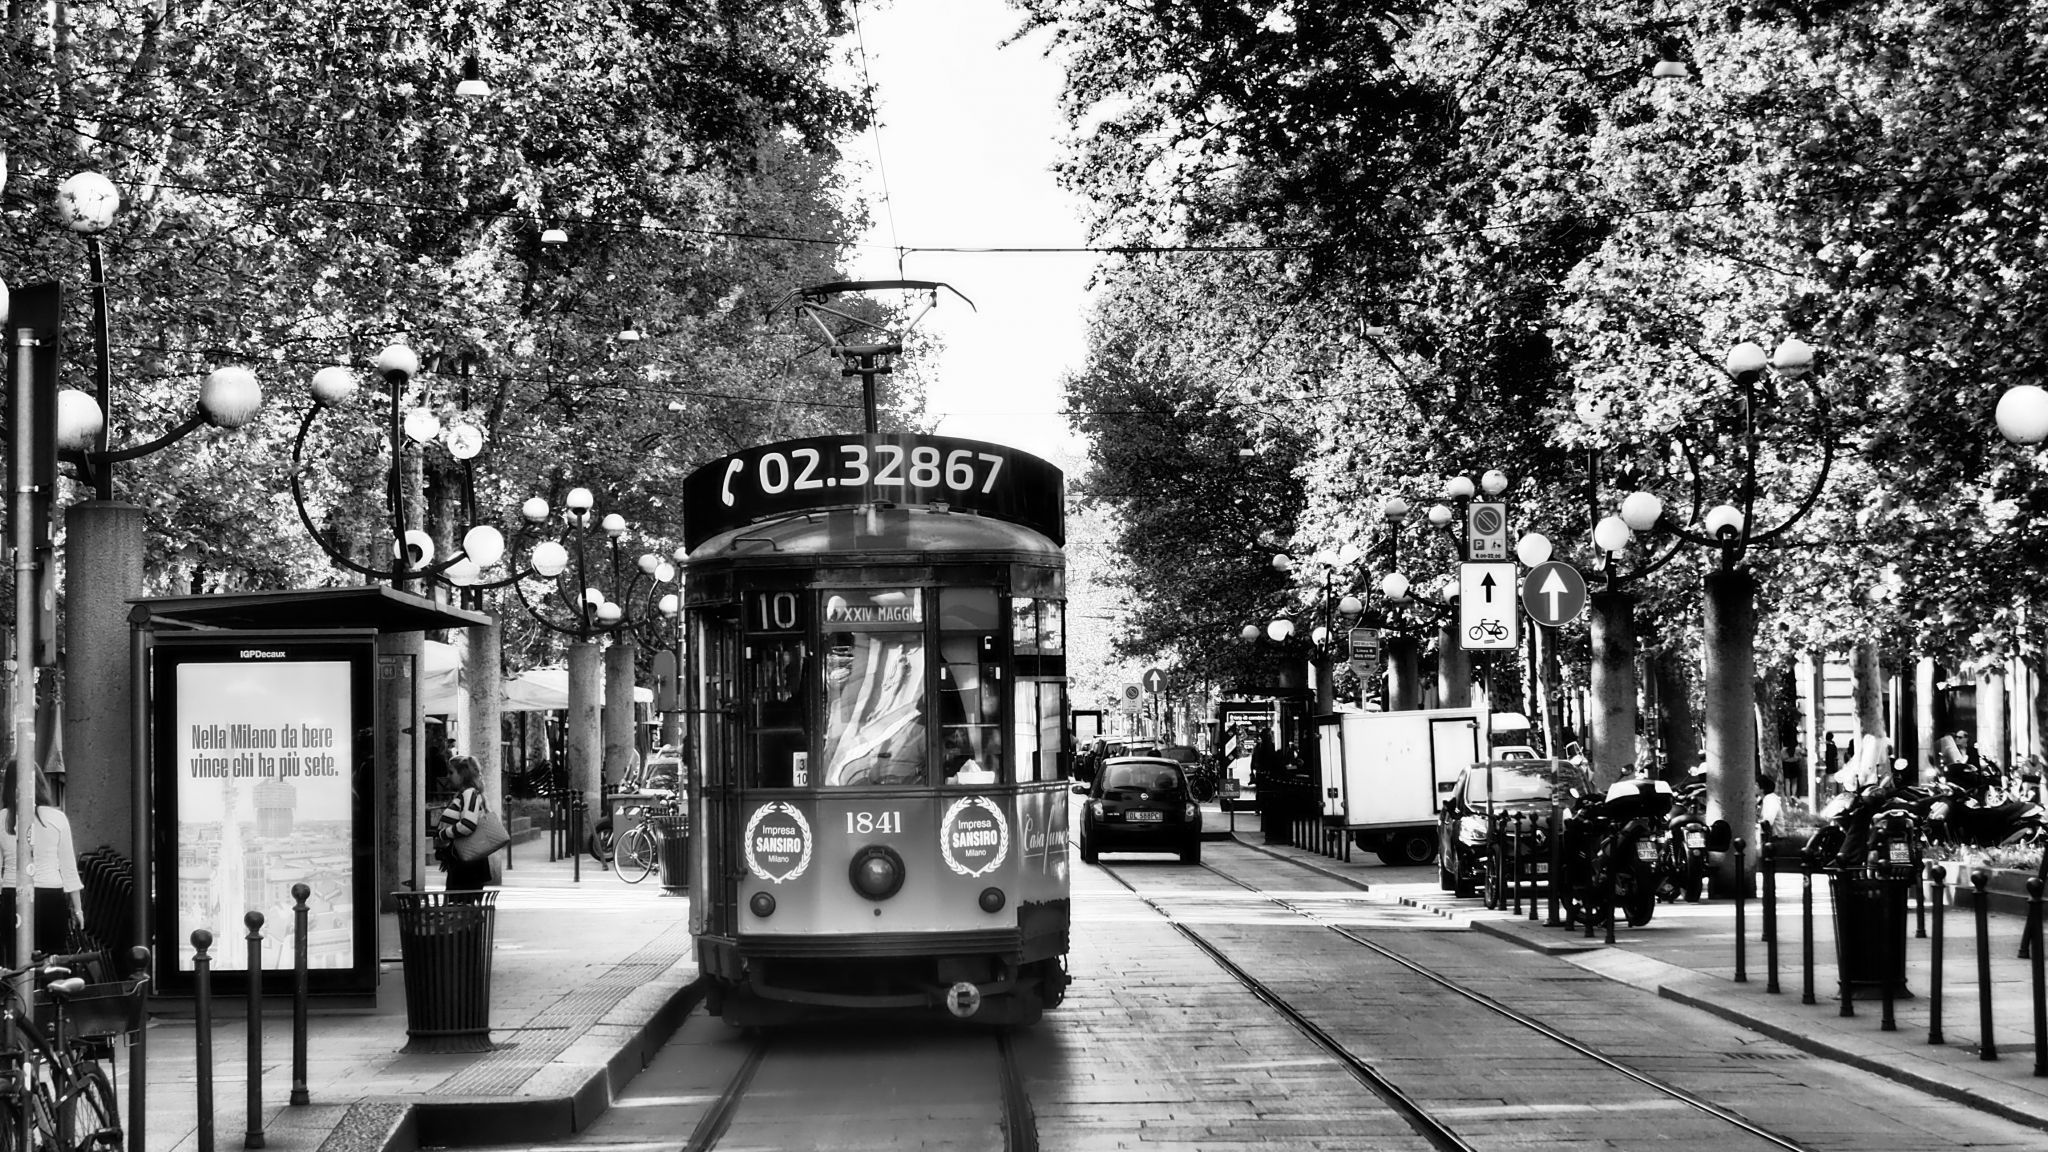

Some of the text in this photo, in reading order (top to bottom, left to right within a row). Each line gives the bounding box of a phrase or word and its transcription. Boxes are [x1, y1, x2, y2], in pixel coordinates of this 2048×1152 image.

[759, 445, 1004, 494] 02.32867
[760, 592, 796, 630] 10
[844, 607, 873, 622] XXIV
[878, 606, 921, 622] MAGGI
[240, 650, 286, 659] IGPDecaux
[191, 723, 333, 750] Nella Milano da bere
[190, 751, 339, 782] vince chi ha più sete.
[799, 759, 805, 771] 3
[796, 773, 808, 785] 10
[846, 811, 901, 834] 1841
[958, 819, 992, 831] Impresa
[762, 825, 796, 837] Impresa
[952, 829, 998, 848] SANSIRO
[756, 837, 801, 853] SANSIRO
[965, 849, 987, 857] Milano
[768, 854, 790, 863] Milano
